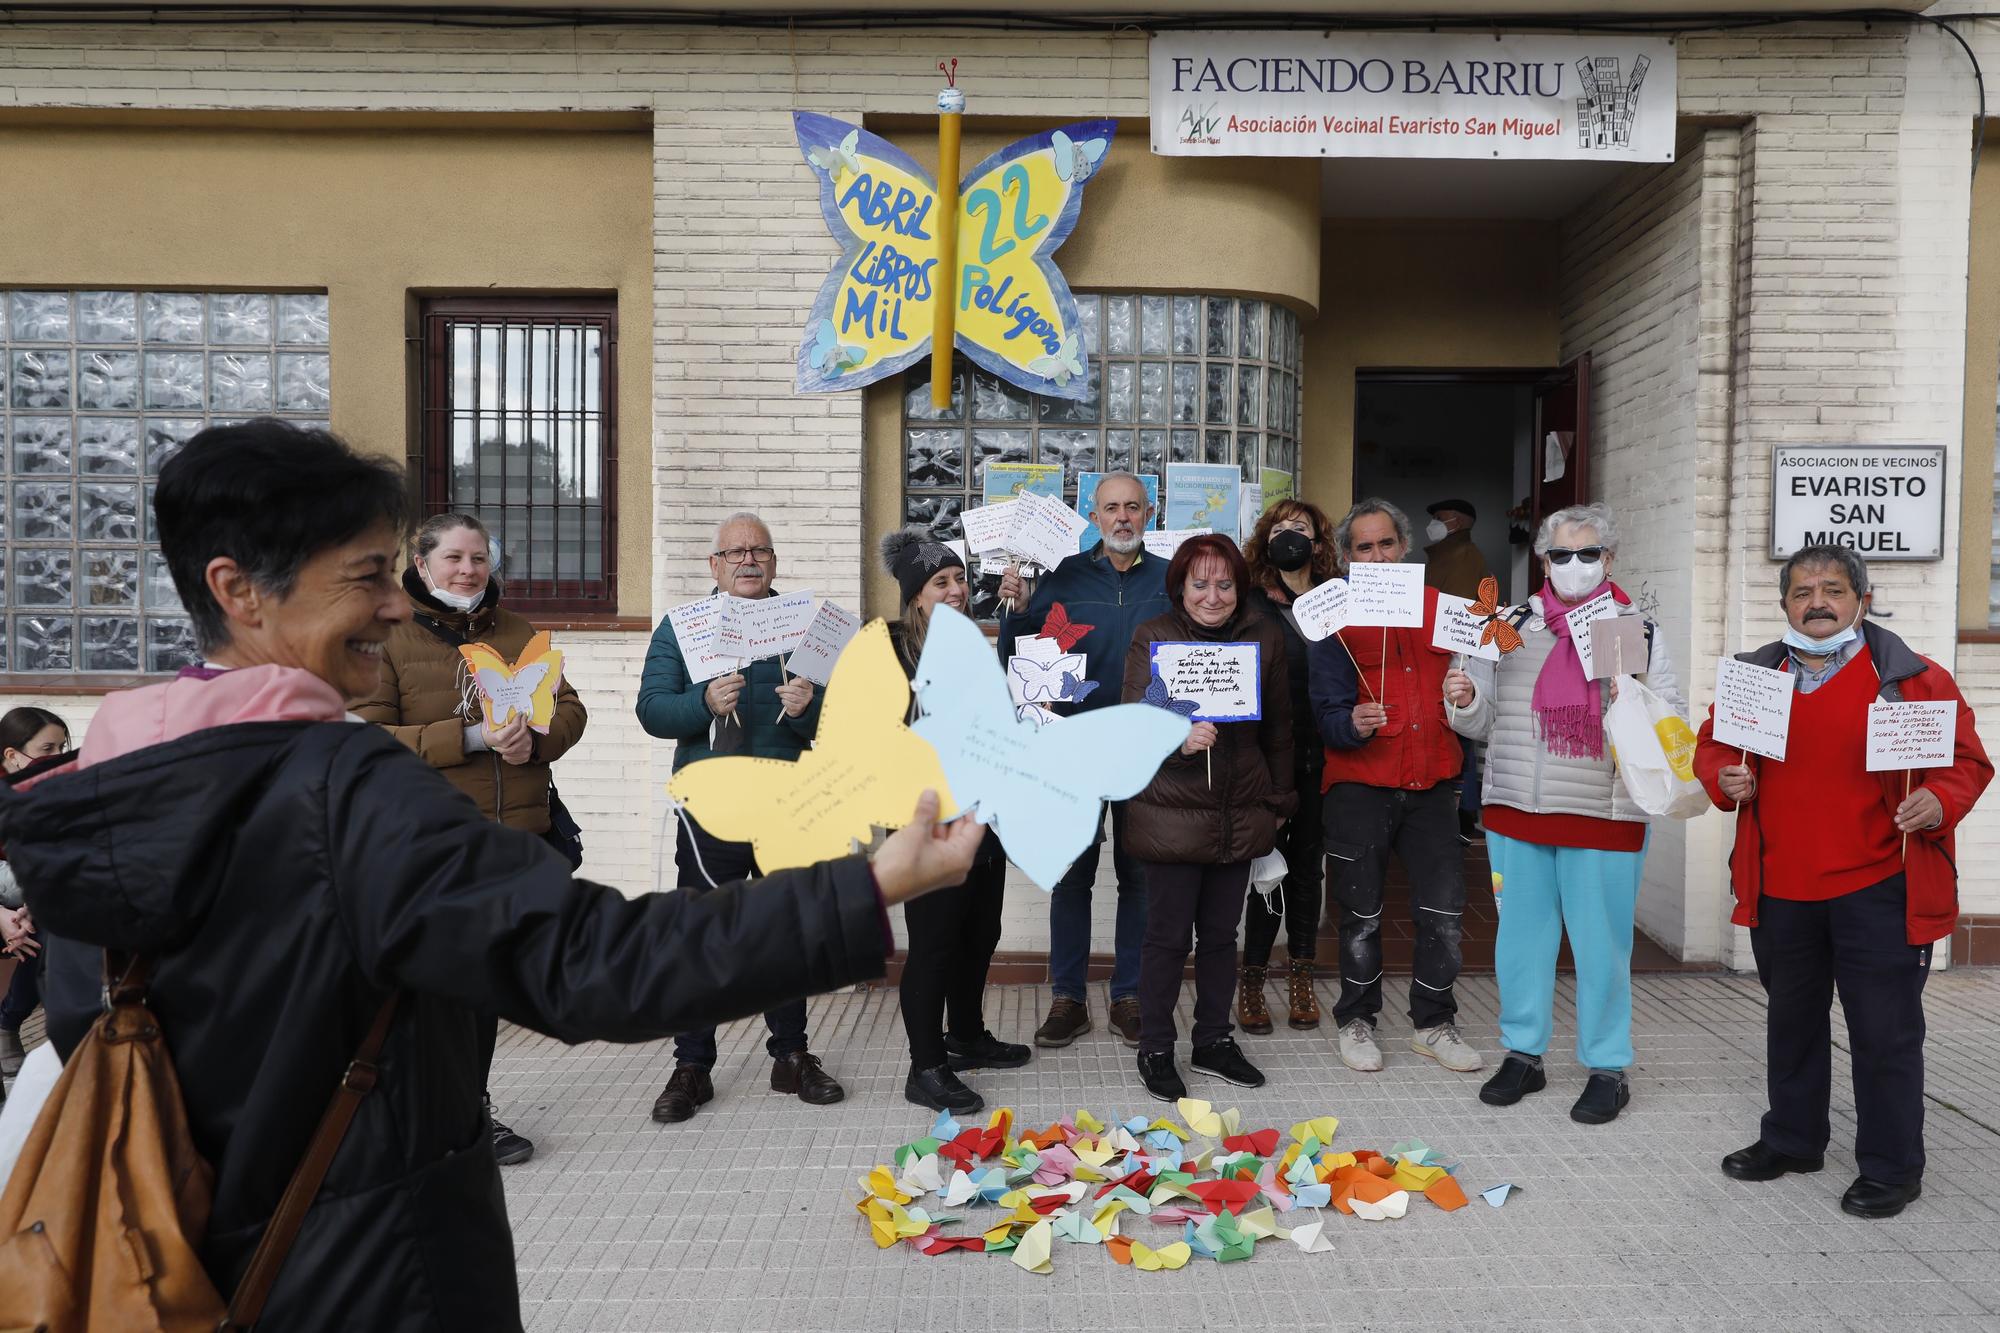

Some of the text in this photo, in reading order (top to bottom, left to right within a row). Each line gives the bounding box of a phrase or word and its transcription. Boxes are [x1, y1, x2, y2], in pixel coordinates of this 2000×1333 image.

[1171, 57, 1565, 97] FACIENDO BARRIU
[1227, 114, 1561, 139] Asociación Vecinal Evaristo San Miguel
[966, 164, 1049, 264] 22
[1780, 457, 1938, 468] ASOCIACION DE VECINOS
[1791, 476, 1926, 497] EVARISTO
[1829, 504, 1885, 524] SAN
[1804, 531, 1911, 552] MIGUEL
